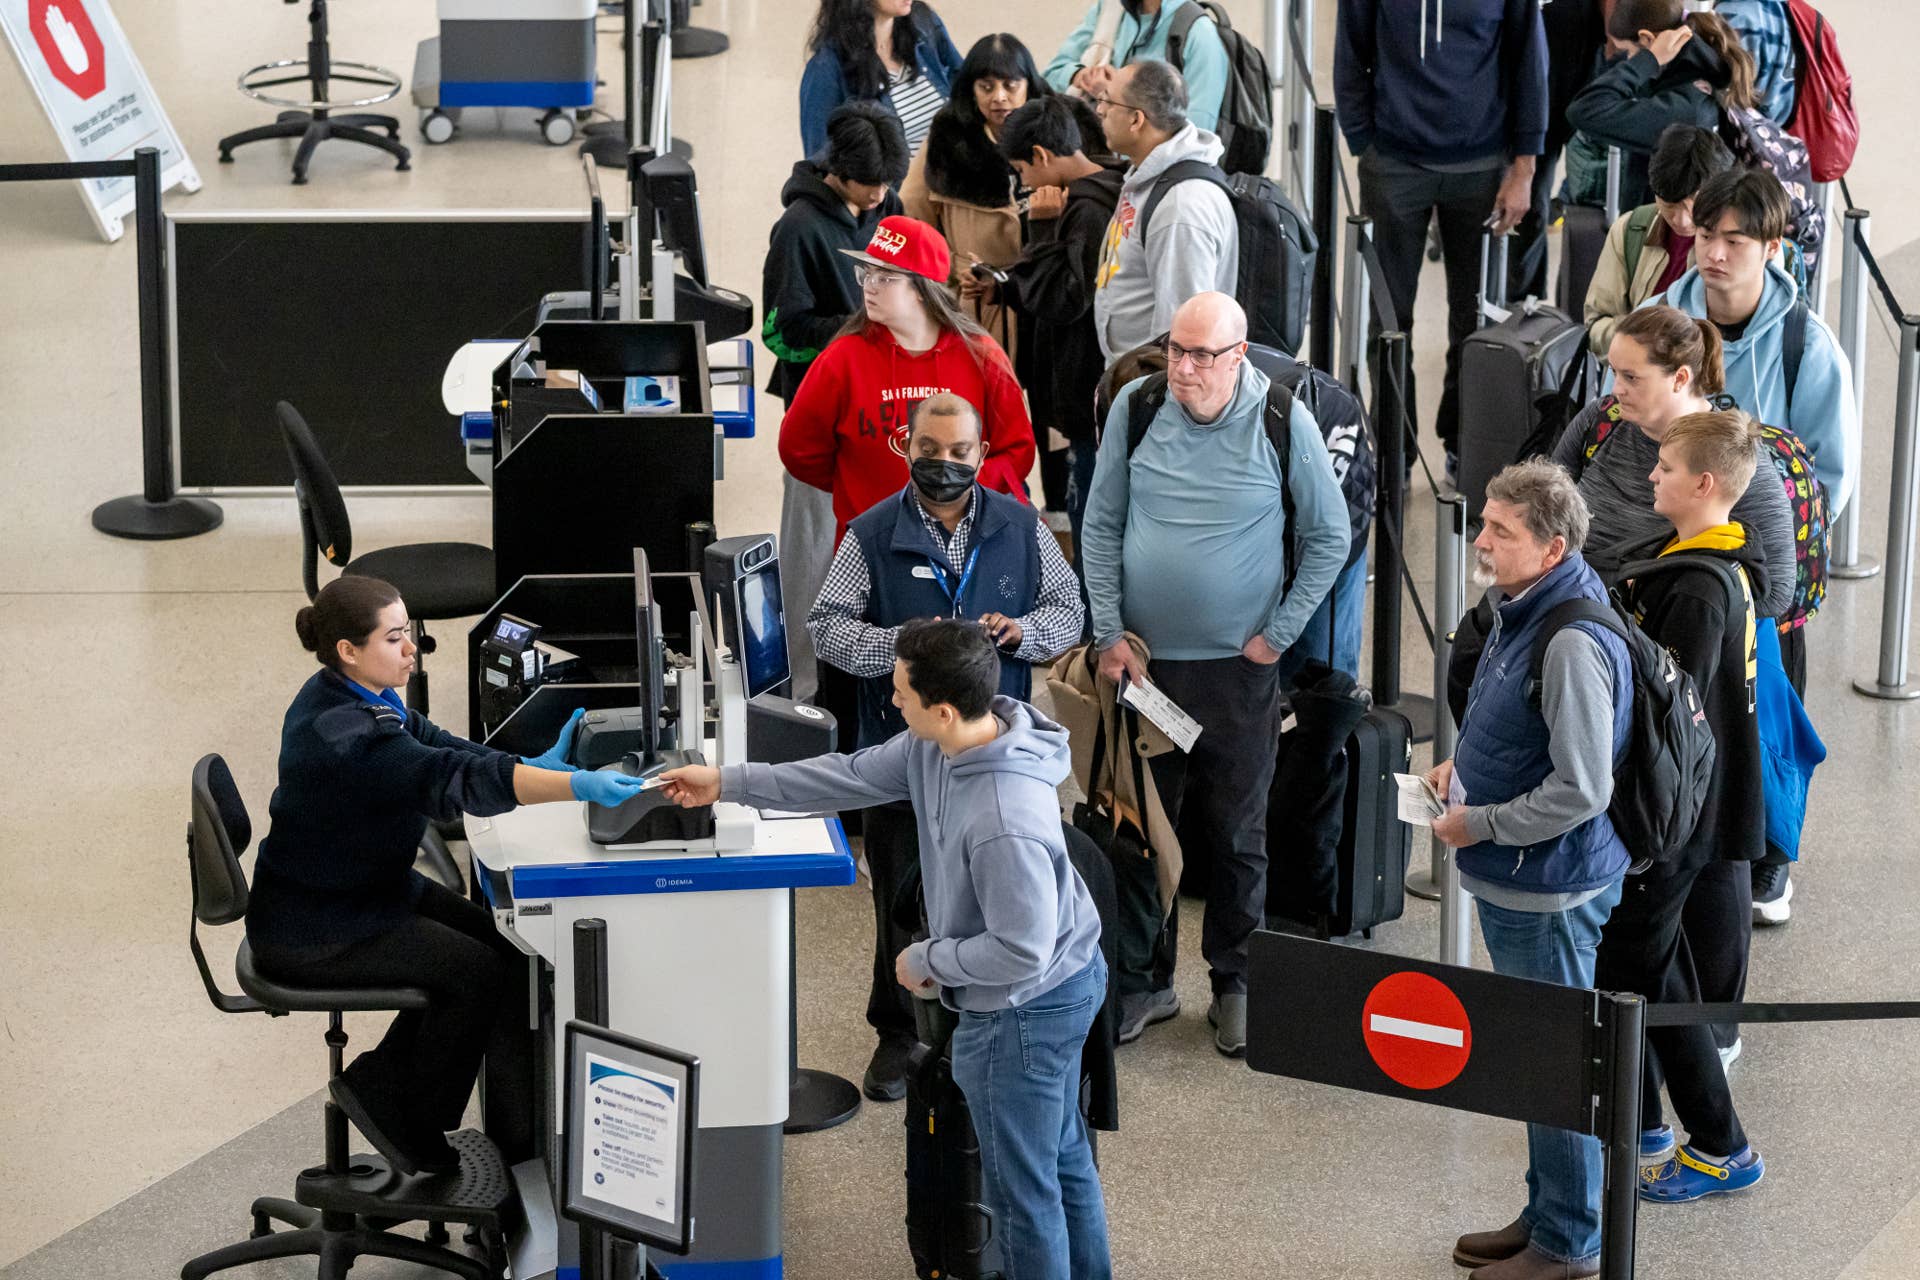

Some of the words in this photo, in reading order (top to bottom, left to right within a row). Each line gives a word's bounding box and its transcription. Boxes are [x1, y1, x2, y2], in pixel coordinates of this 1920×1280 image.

[598, 1084, 614, 1093] Please
[621, 1092, 637, 1101] ready
[602, 1113, 614, 1121] Take
[602, 1141, 613, 1150] Take
